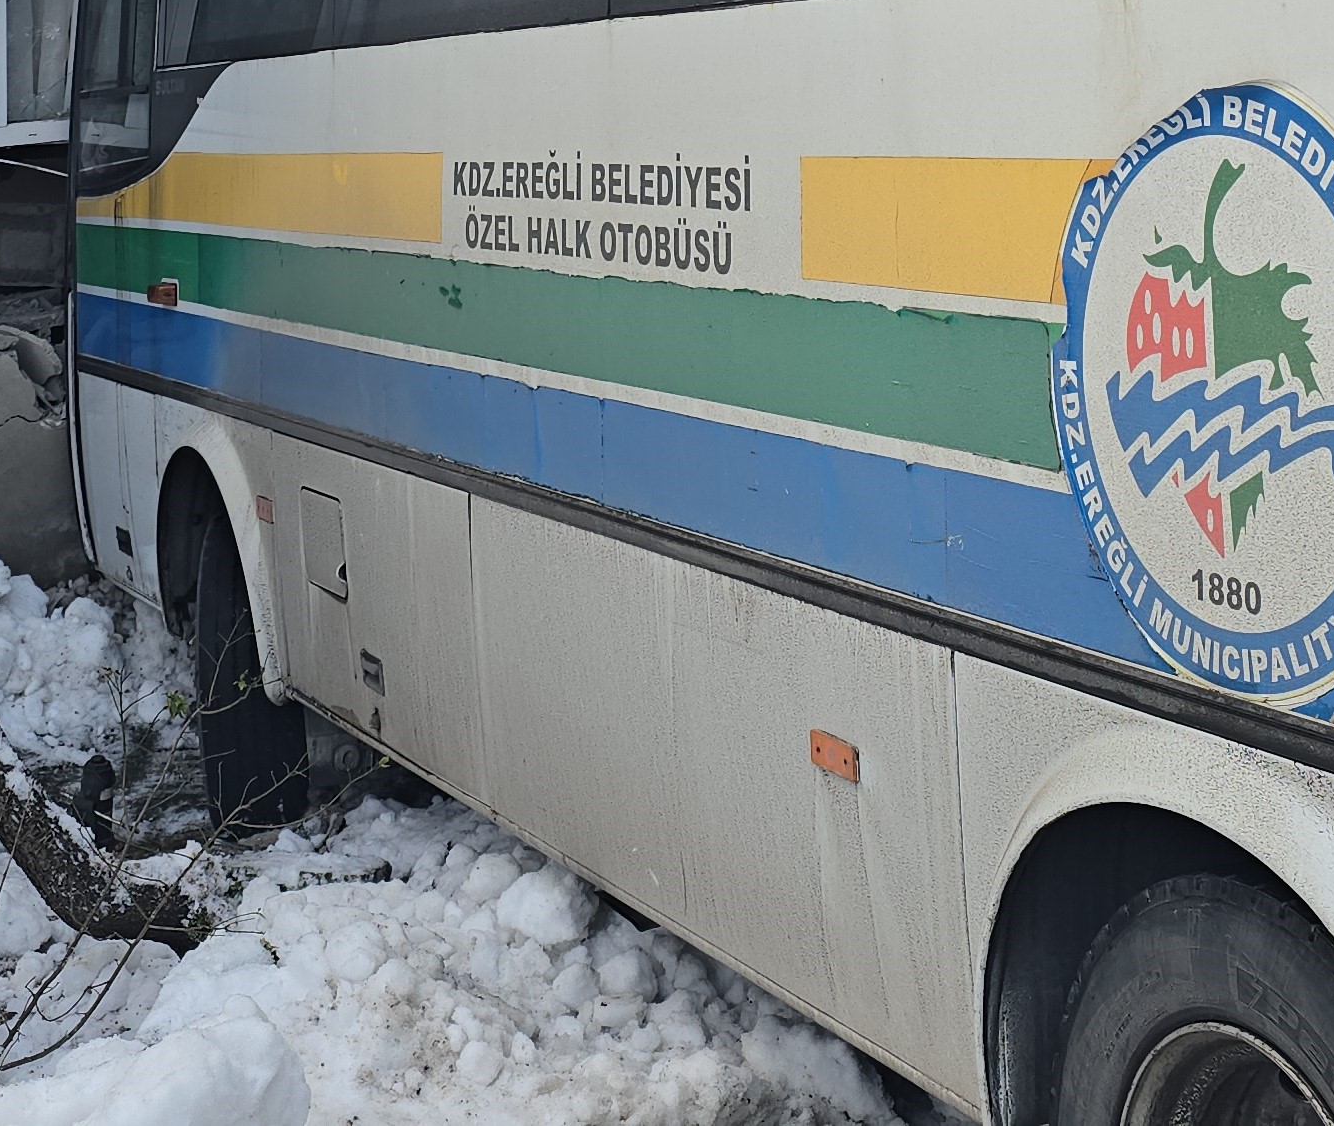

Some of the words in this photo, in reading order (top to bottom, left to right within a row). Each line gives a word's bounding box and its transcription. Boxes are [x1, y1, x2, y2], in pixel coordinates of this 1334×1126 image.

[453, 149, 582, 201] KDZ.EREĞLİ
[591, 153, 751, 212] BELEDİYESİ
[465, 205, 520, 253] ÖZEL
[527, 216, 592, 260] HALK
[600, 218, 732, 275] OTOBÜSÜ
[1059, 359, 1148, 607] KDZ.EREĞLİ
[1191, 569, 1262, 615] 1880
